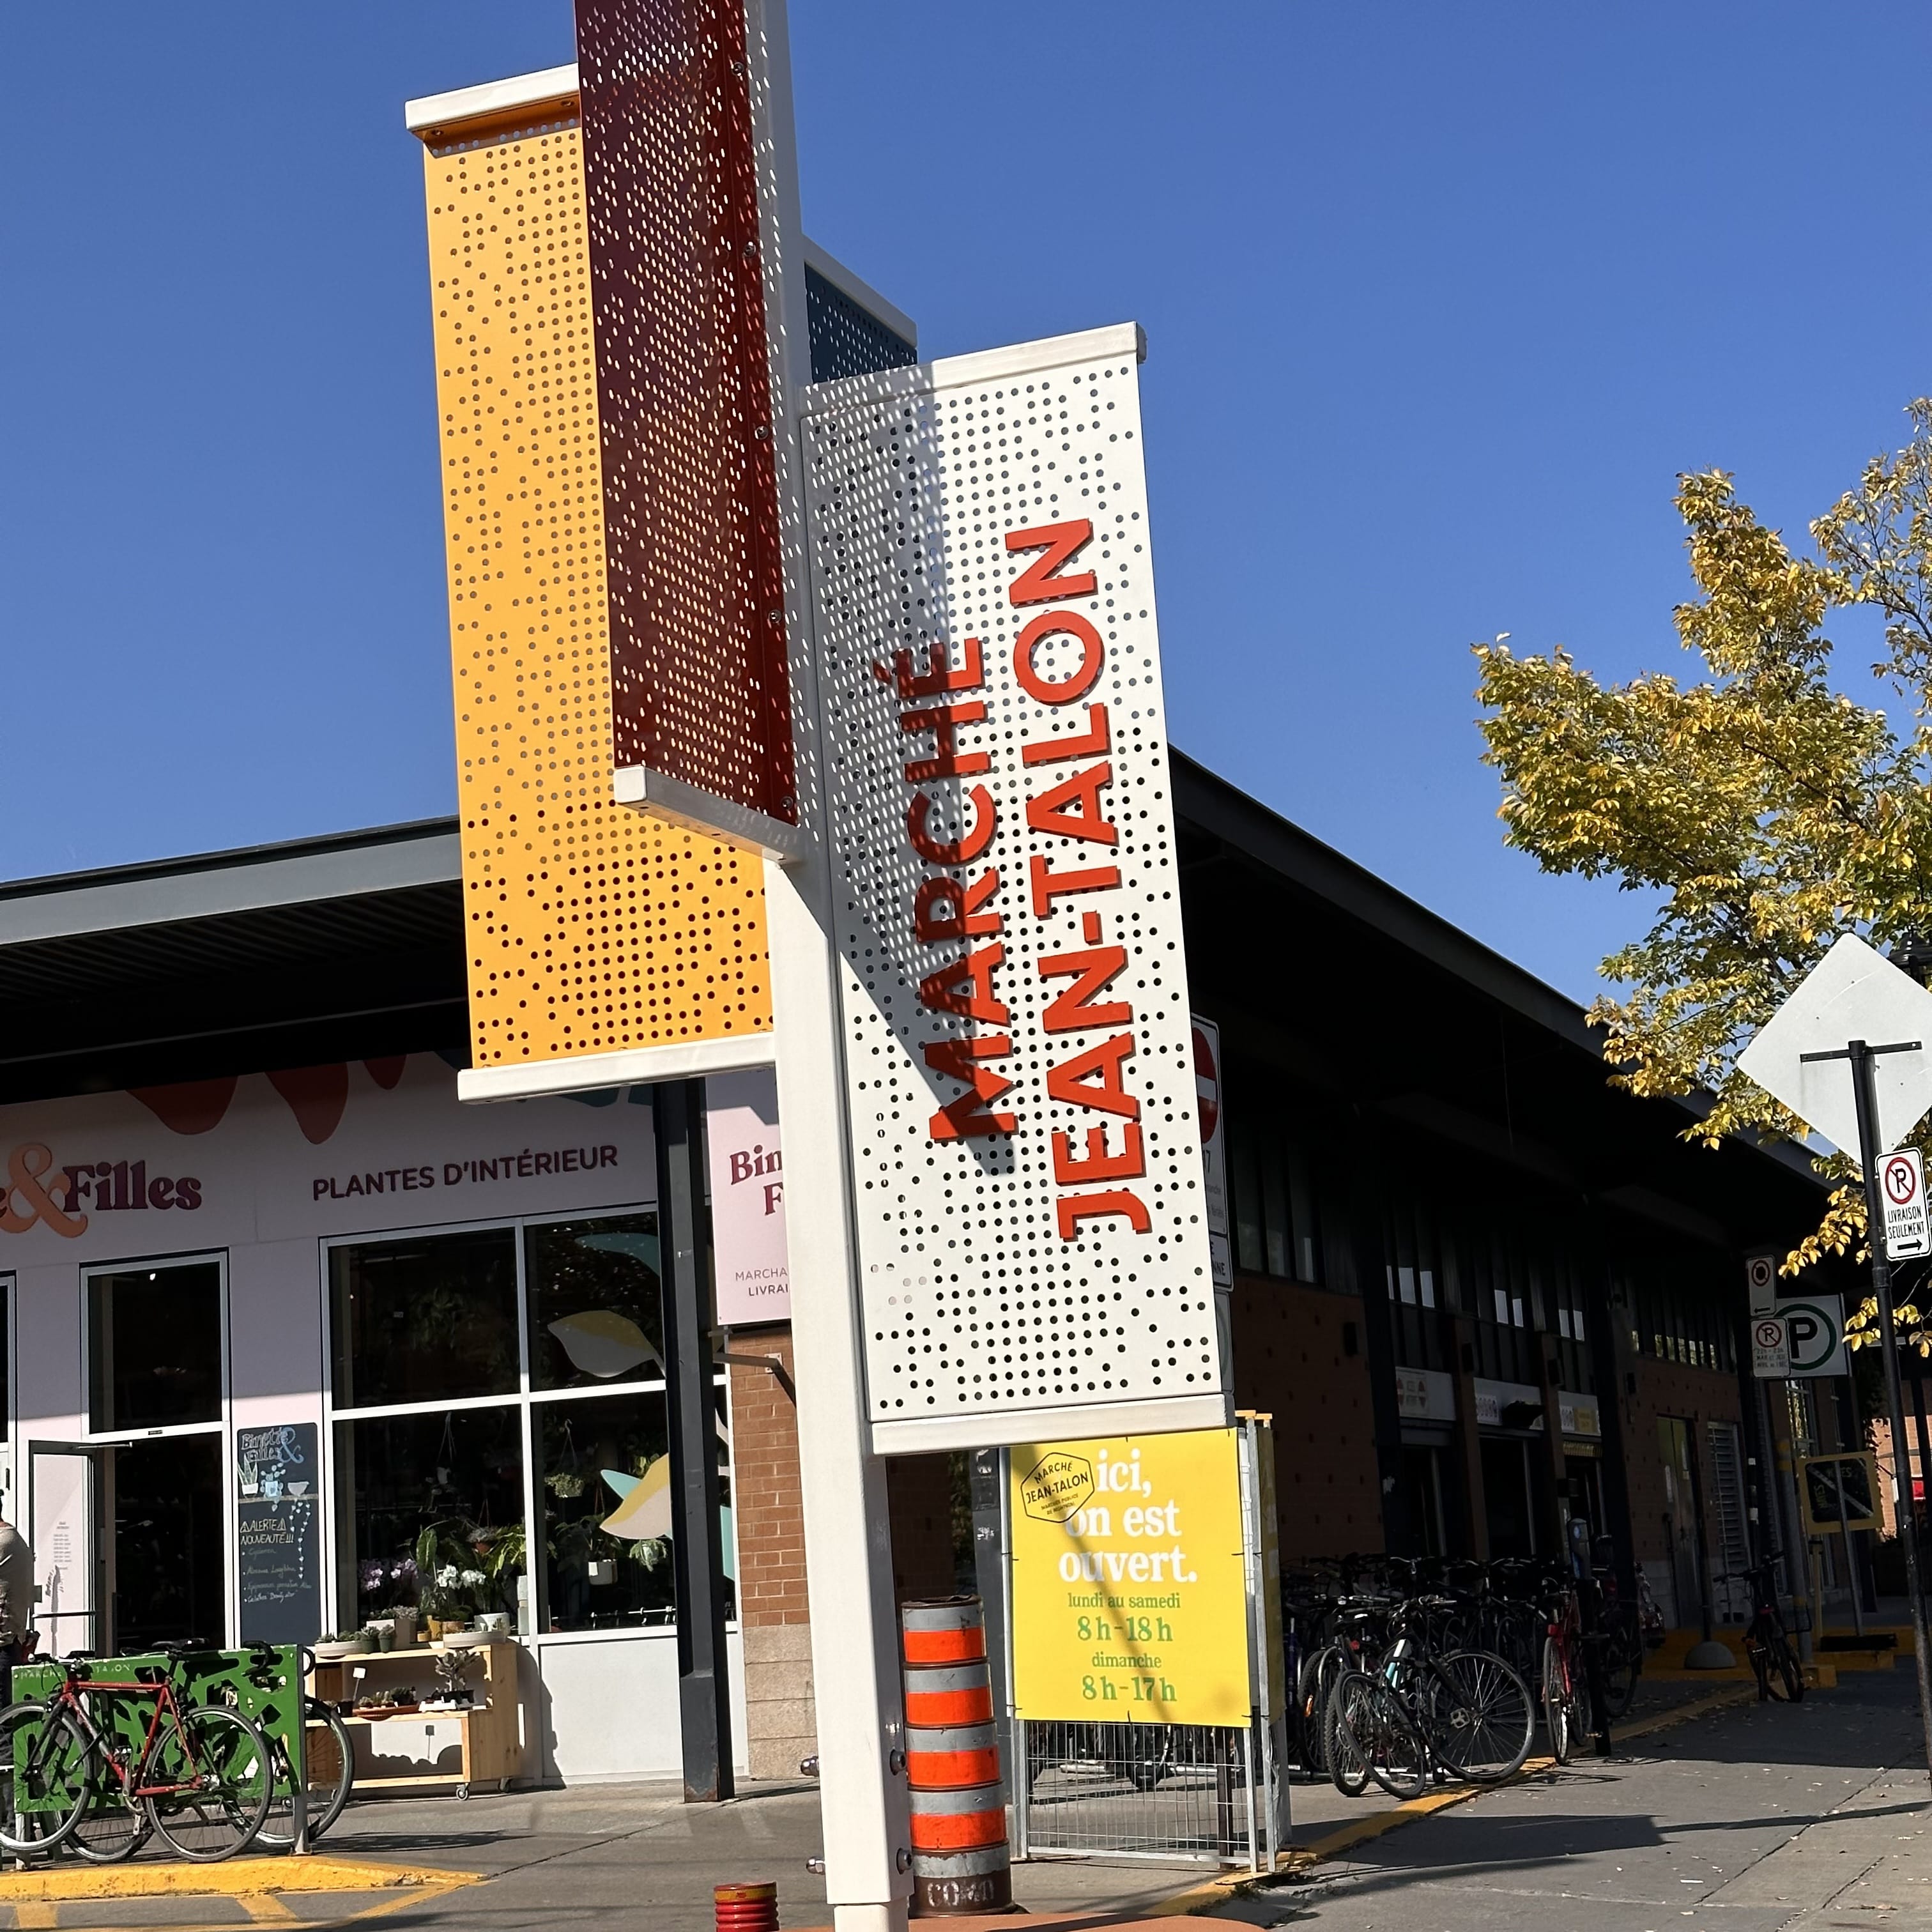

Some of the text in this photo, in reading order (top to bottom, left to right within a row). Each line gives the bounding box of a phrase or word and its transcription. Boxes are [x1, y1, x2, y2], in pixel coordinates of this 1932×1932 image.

[873, 636, 1018, 1144] MARCHÉ
[1005, 518, 1152, 1242] JEAN-TALON
[62, 1160, 202, 1213] Filles
[312, 1145, 618, 1201] PLANTES D'INTÉRIEUR
[1887, 1205, 1922, 1223] LIVRAISON
[1888, 1221, 1925, 1239] SEULEMENT
[1025, 1471, 1089, 1504] JEAN-TALON
[1034, 1460, 1073, 1484] MARCHÉ
[1096, 1447, 1152, 1498] ici,
[1064, 1498, 1183, 1538] on est
[1058, 1544, 1198, 1583] ouvert.
[1068, 1591, 1181, 1609] lundi au samedi
[1091, 1650, 1162, 1668] dimanche
